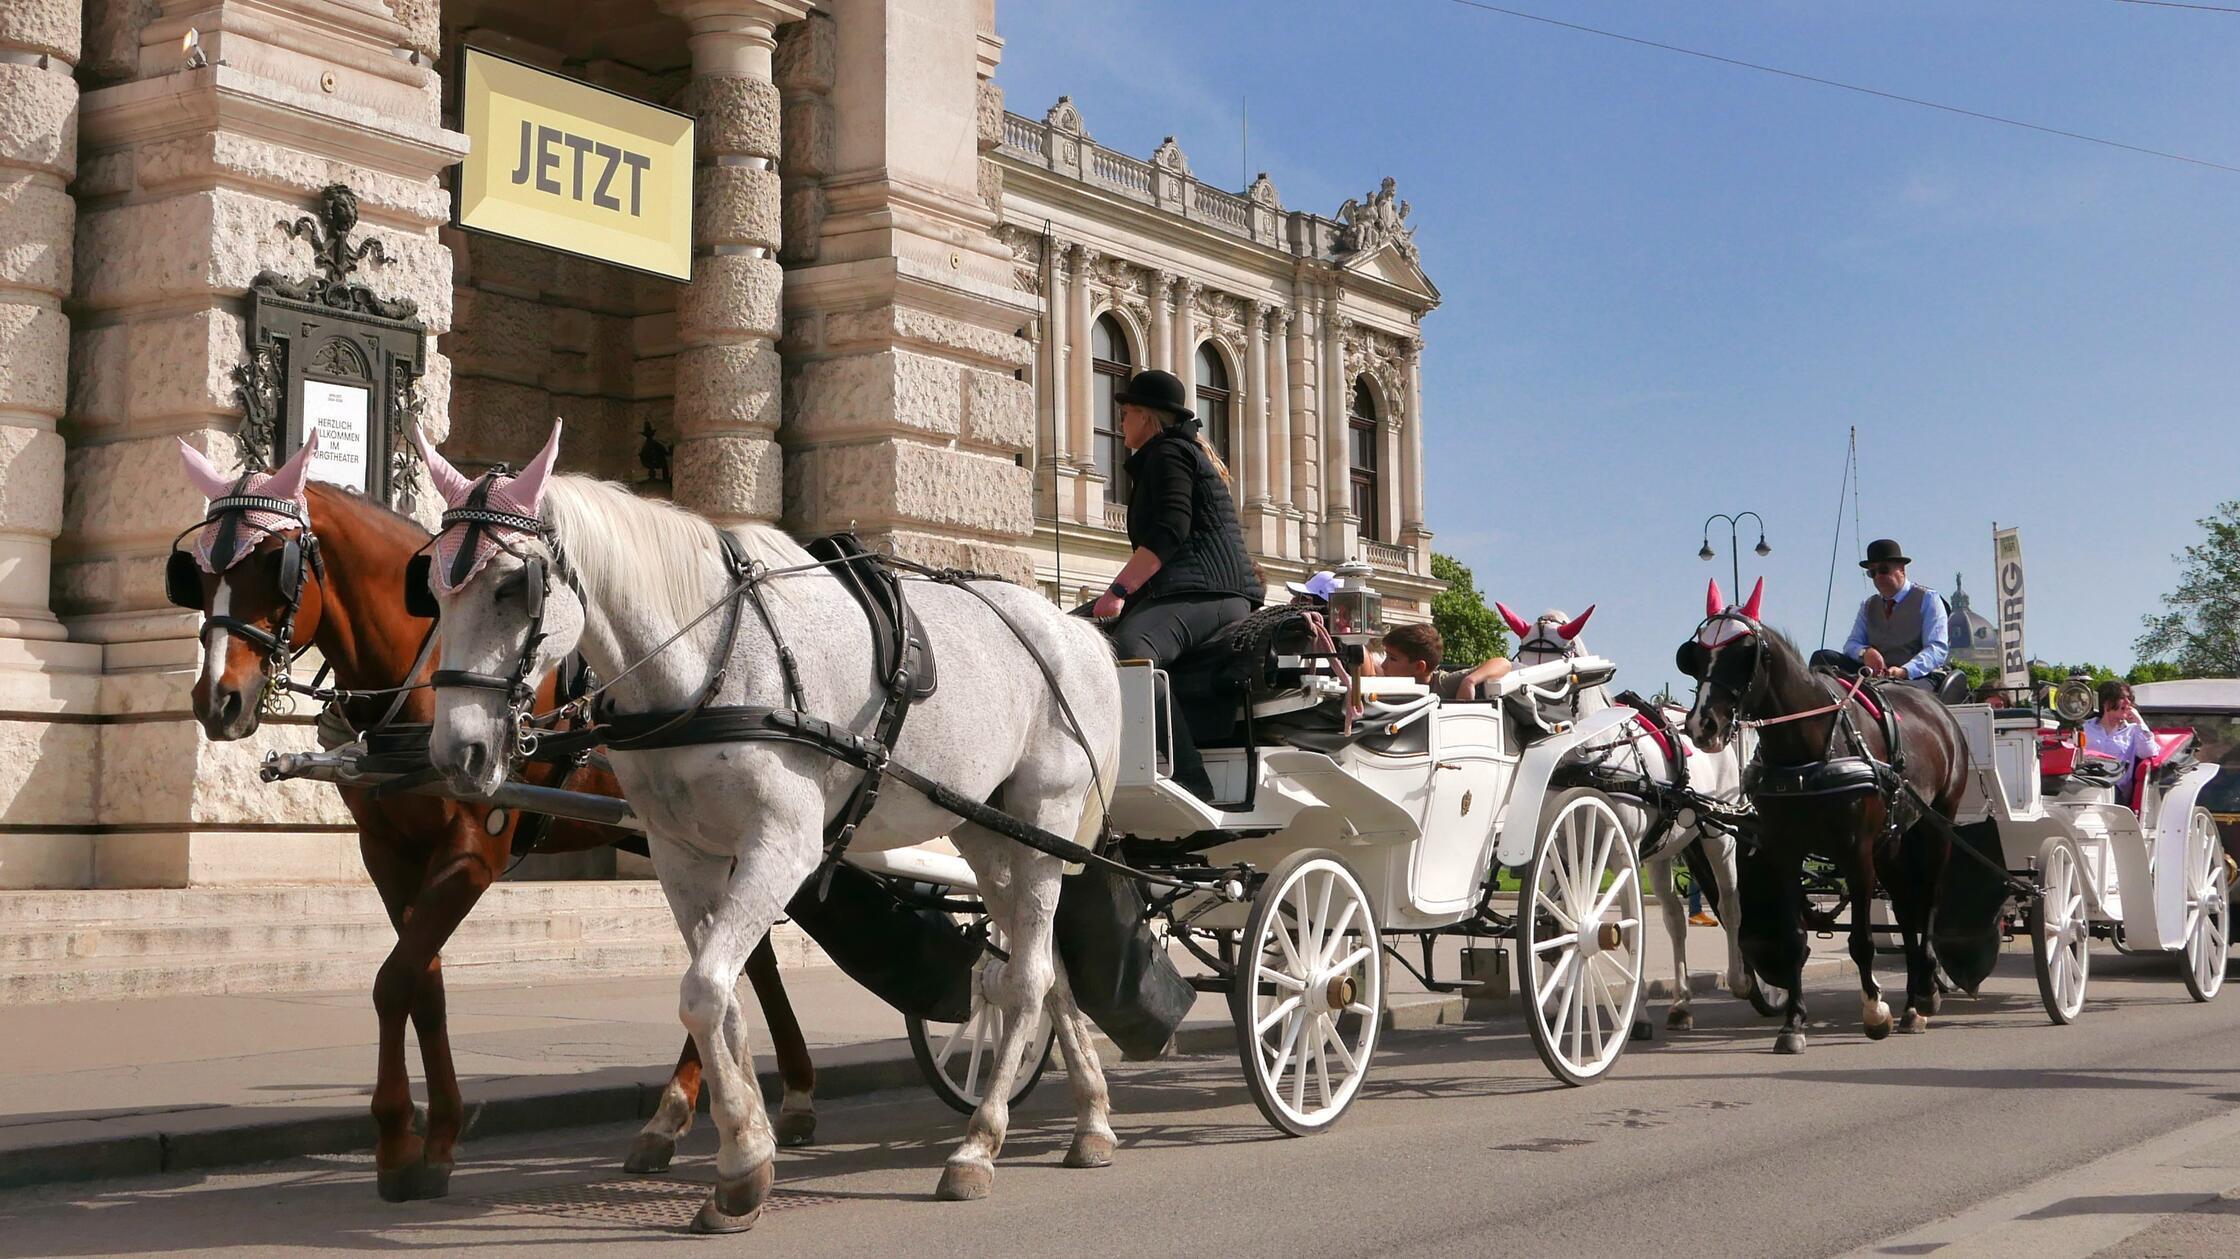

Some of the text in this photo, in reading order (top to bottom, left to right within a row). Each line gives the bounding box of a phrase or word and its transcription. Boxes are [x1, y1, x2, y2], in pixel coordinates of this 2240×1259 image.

[512, 120, 651, 217] JETZT
[318, 418, 352, 430] HERZLICH
[310, 427, 360, 442] LLKOMMEN
[330, 441, 339, 450] IM
[313, 450, 359, 463] URGTHEATER
[2002, 562, 2024, 673] BURG
